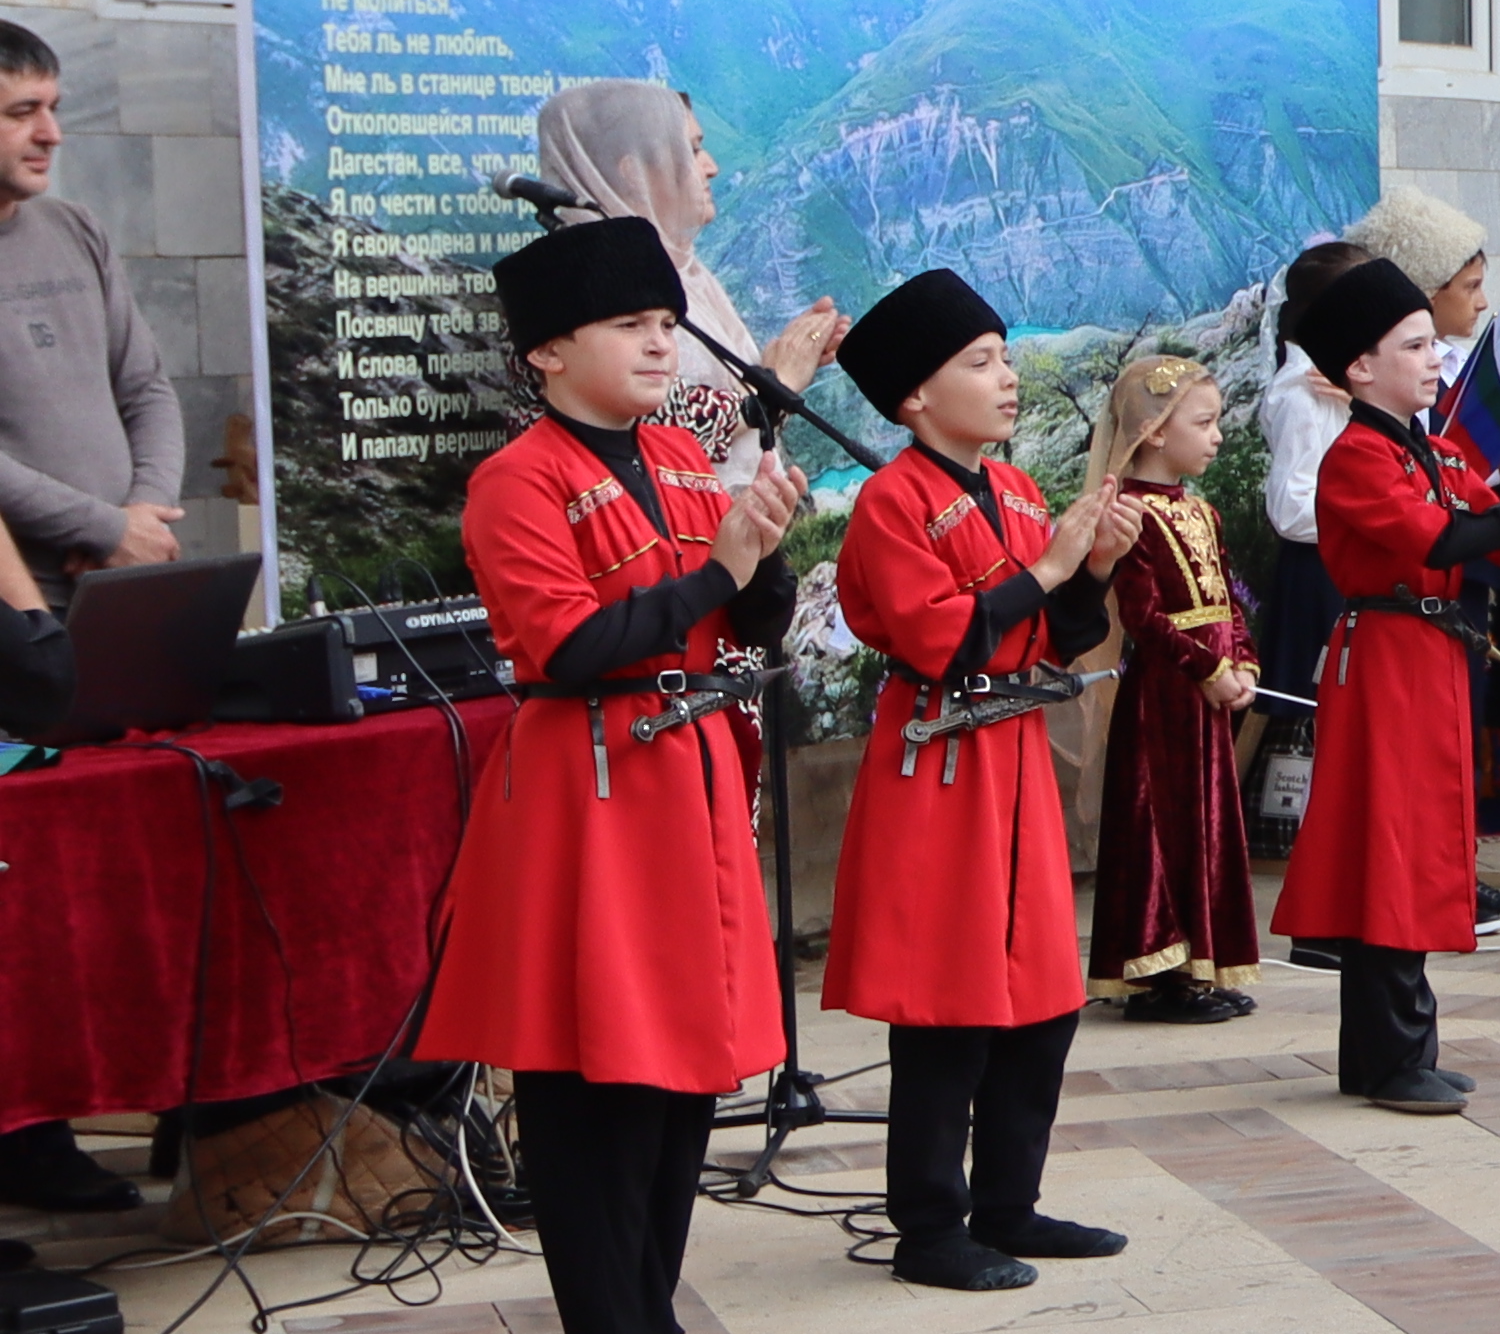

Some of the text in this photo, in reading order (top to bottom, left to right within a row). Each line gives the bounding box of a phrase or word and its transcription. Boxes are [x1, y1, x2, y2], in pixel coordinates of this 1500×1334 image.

[323, 23, 514, 60] Тебя ль не любить,
[324, 65, 366, 94] Мне
[371, 71, 397, 94] ль
[402, 72, 414, 94] в
[418, 71, 496, 99] станице
[500, 69, 554, 96] твоей
[326, 106, 473, 135] Отколовшейся
[328, 146, 423, 180] Дагестан,
[428, 153, 467, 179] все,
[471, 152, 503, 175] что
[330, 187, 345, 216] Я
[351, 193, 376, 216] по
[380, 192, 436, 216] чести
[440, 192, 452, 215] с
[332, 229, 349, 257] Я
[352, 233, 399, 257] свои
[405, 232, 476, 261] ордена
[480, 232, 492, 254] и
[333, 270, 361, 298] На
[365, 273, 458, 303] вершины
[335, 310, 425, 343] Посвящу
[429, 307, 474, 334] тебе
[337, 351, 353, 380] И
[358, 352, 423, 379] слова,
[338, 392, 412, 420] Только
[416, 389, 472, 422] бурку
[341, 430, 508, 463] И папаху вершин
[419, 607, 489, 628] DYNACORD
